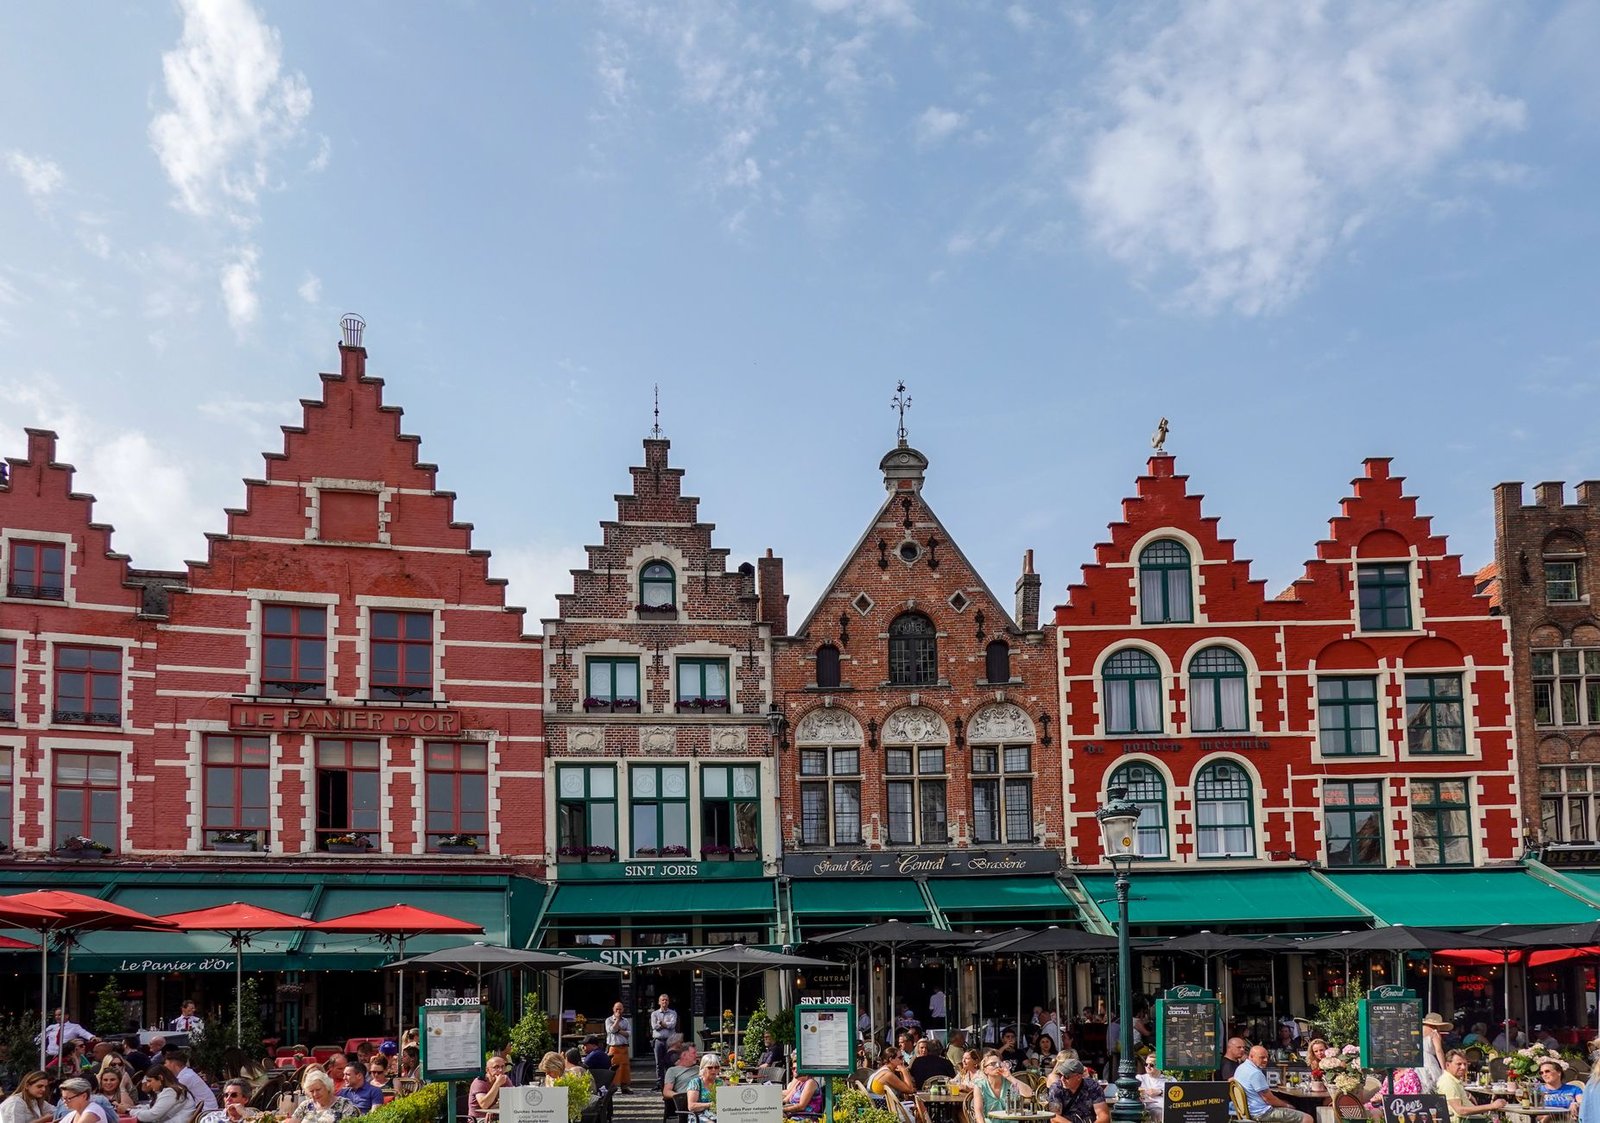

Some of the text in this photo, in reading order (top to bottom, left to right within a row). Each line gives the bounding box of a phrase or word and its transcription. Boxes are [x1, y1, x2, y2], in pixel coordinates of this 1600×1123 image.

[240, 710, 275, 727] LE
[283, 708, 384, 730] PANIER
[625, 865, 698, 876] SINT JORIS
[814, 859, 849, 875] Grand
[896, 854, 945, 874] Central
[967, 857, 1027, 870] Brasserie
[599, 949, 712, 966] SINT-JO
[121, 959, 234, 971] Le Panier d'Or
[1176, 986, 1202, 999] Central
[1380, 987, 1405, 999] Central
[425, 997, 480, 1007] SINT JORIS
[800, 996, 851, 1005] SINT JORIS
[1172, 1101, 1192, 1109] CENTRAL
[1390, 1098, 1423, 1116] Beer
